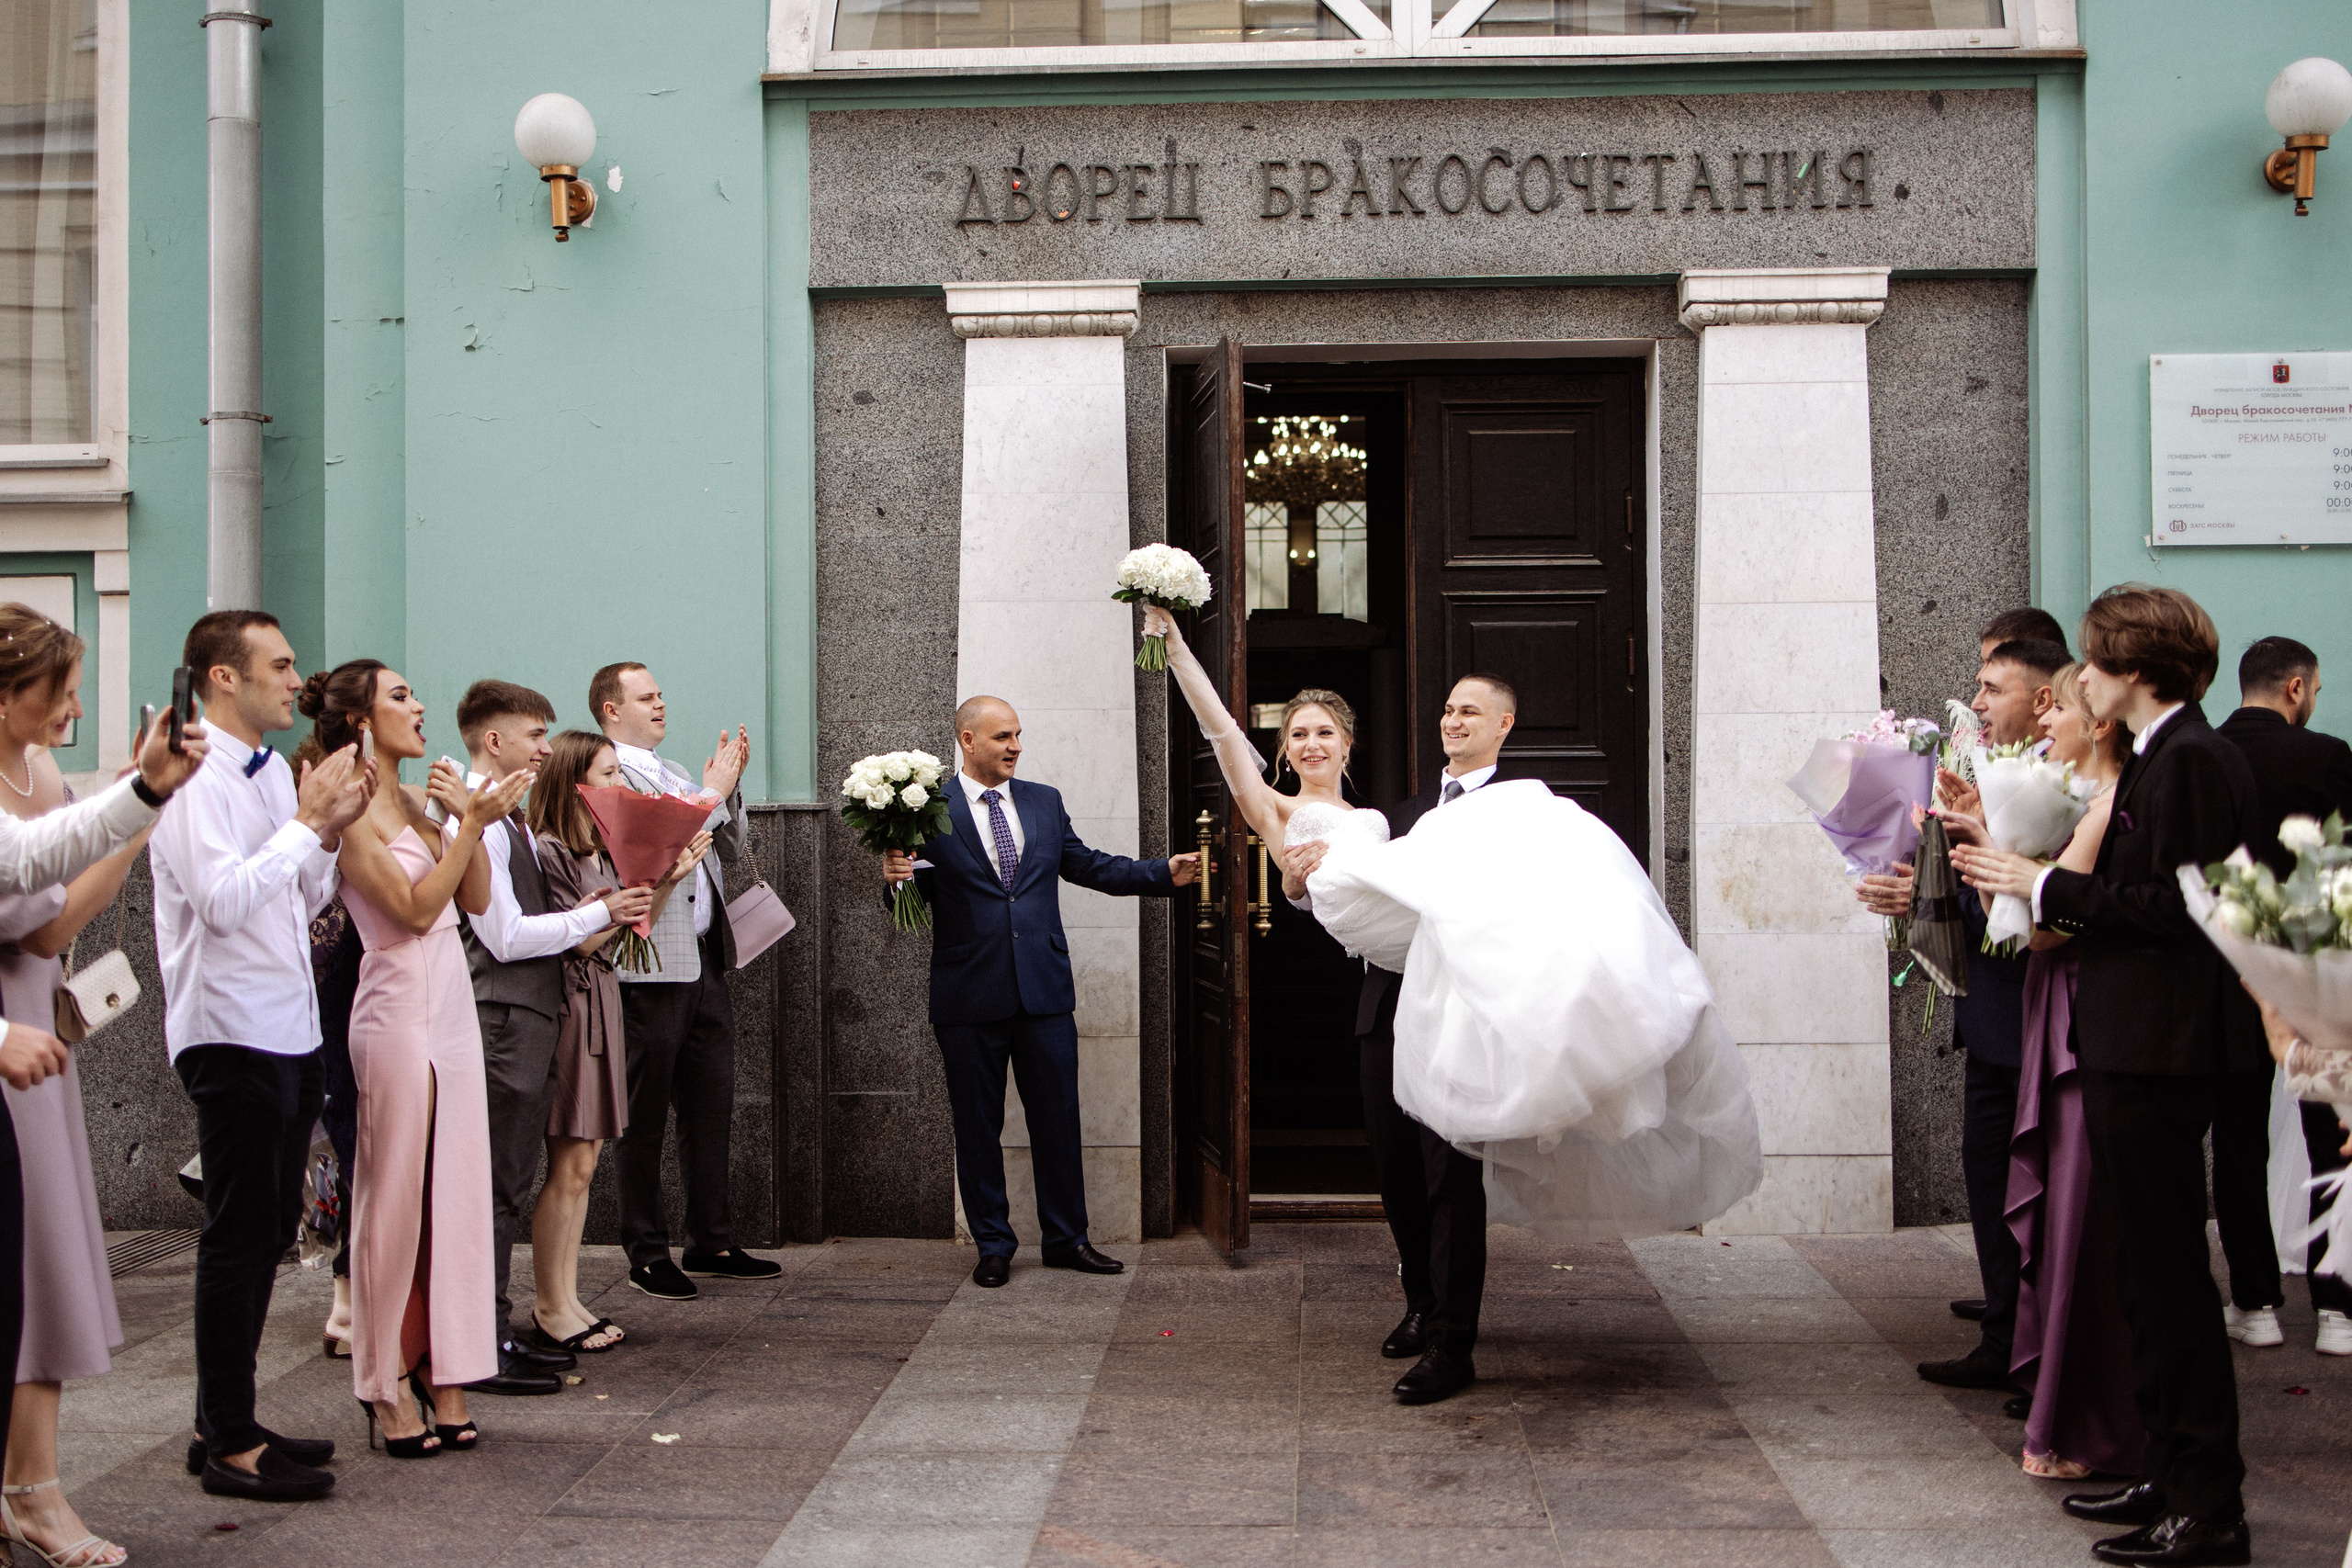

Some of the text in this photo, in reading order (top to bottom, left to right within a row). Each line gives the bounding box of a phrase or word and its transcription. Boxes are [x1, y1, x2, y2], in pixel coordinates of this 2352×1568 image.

[956, 148, 1875, 228] ДВОРЕЦ БРАКОСОЧЕТАНИЯ
[2190, 405, 2239, 418] Дворец
[2242, 404, 2345, 418] бракосочетания
[2238, 432, 2326, 443] РЕЖИМ РАБОТЫ
[2333, 447, 2352, 457] 9:0
[2334, 464, 2352, 474] 9:0
[2334, 480, 2352, 491] 9:0
[2326, 497, 2352, 508] 00:0
